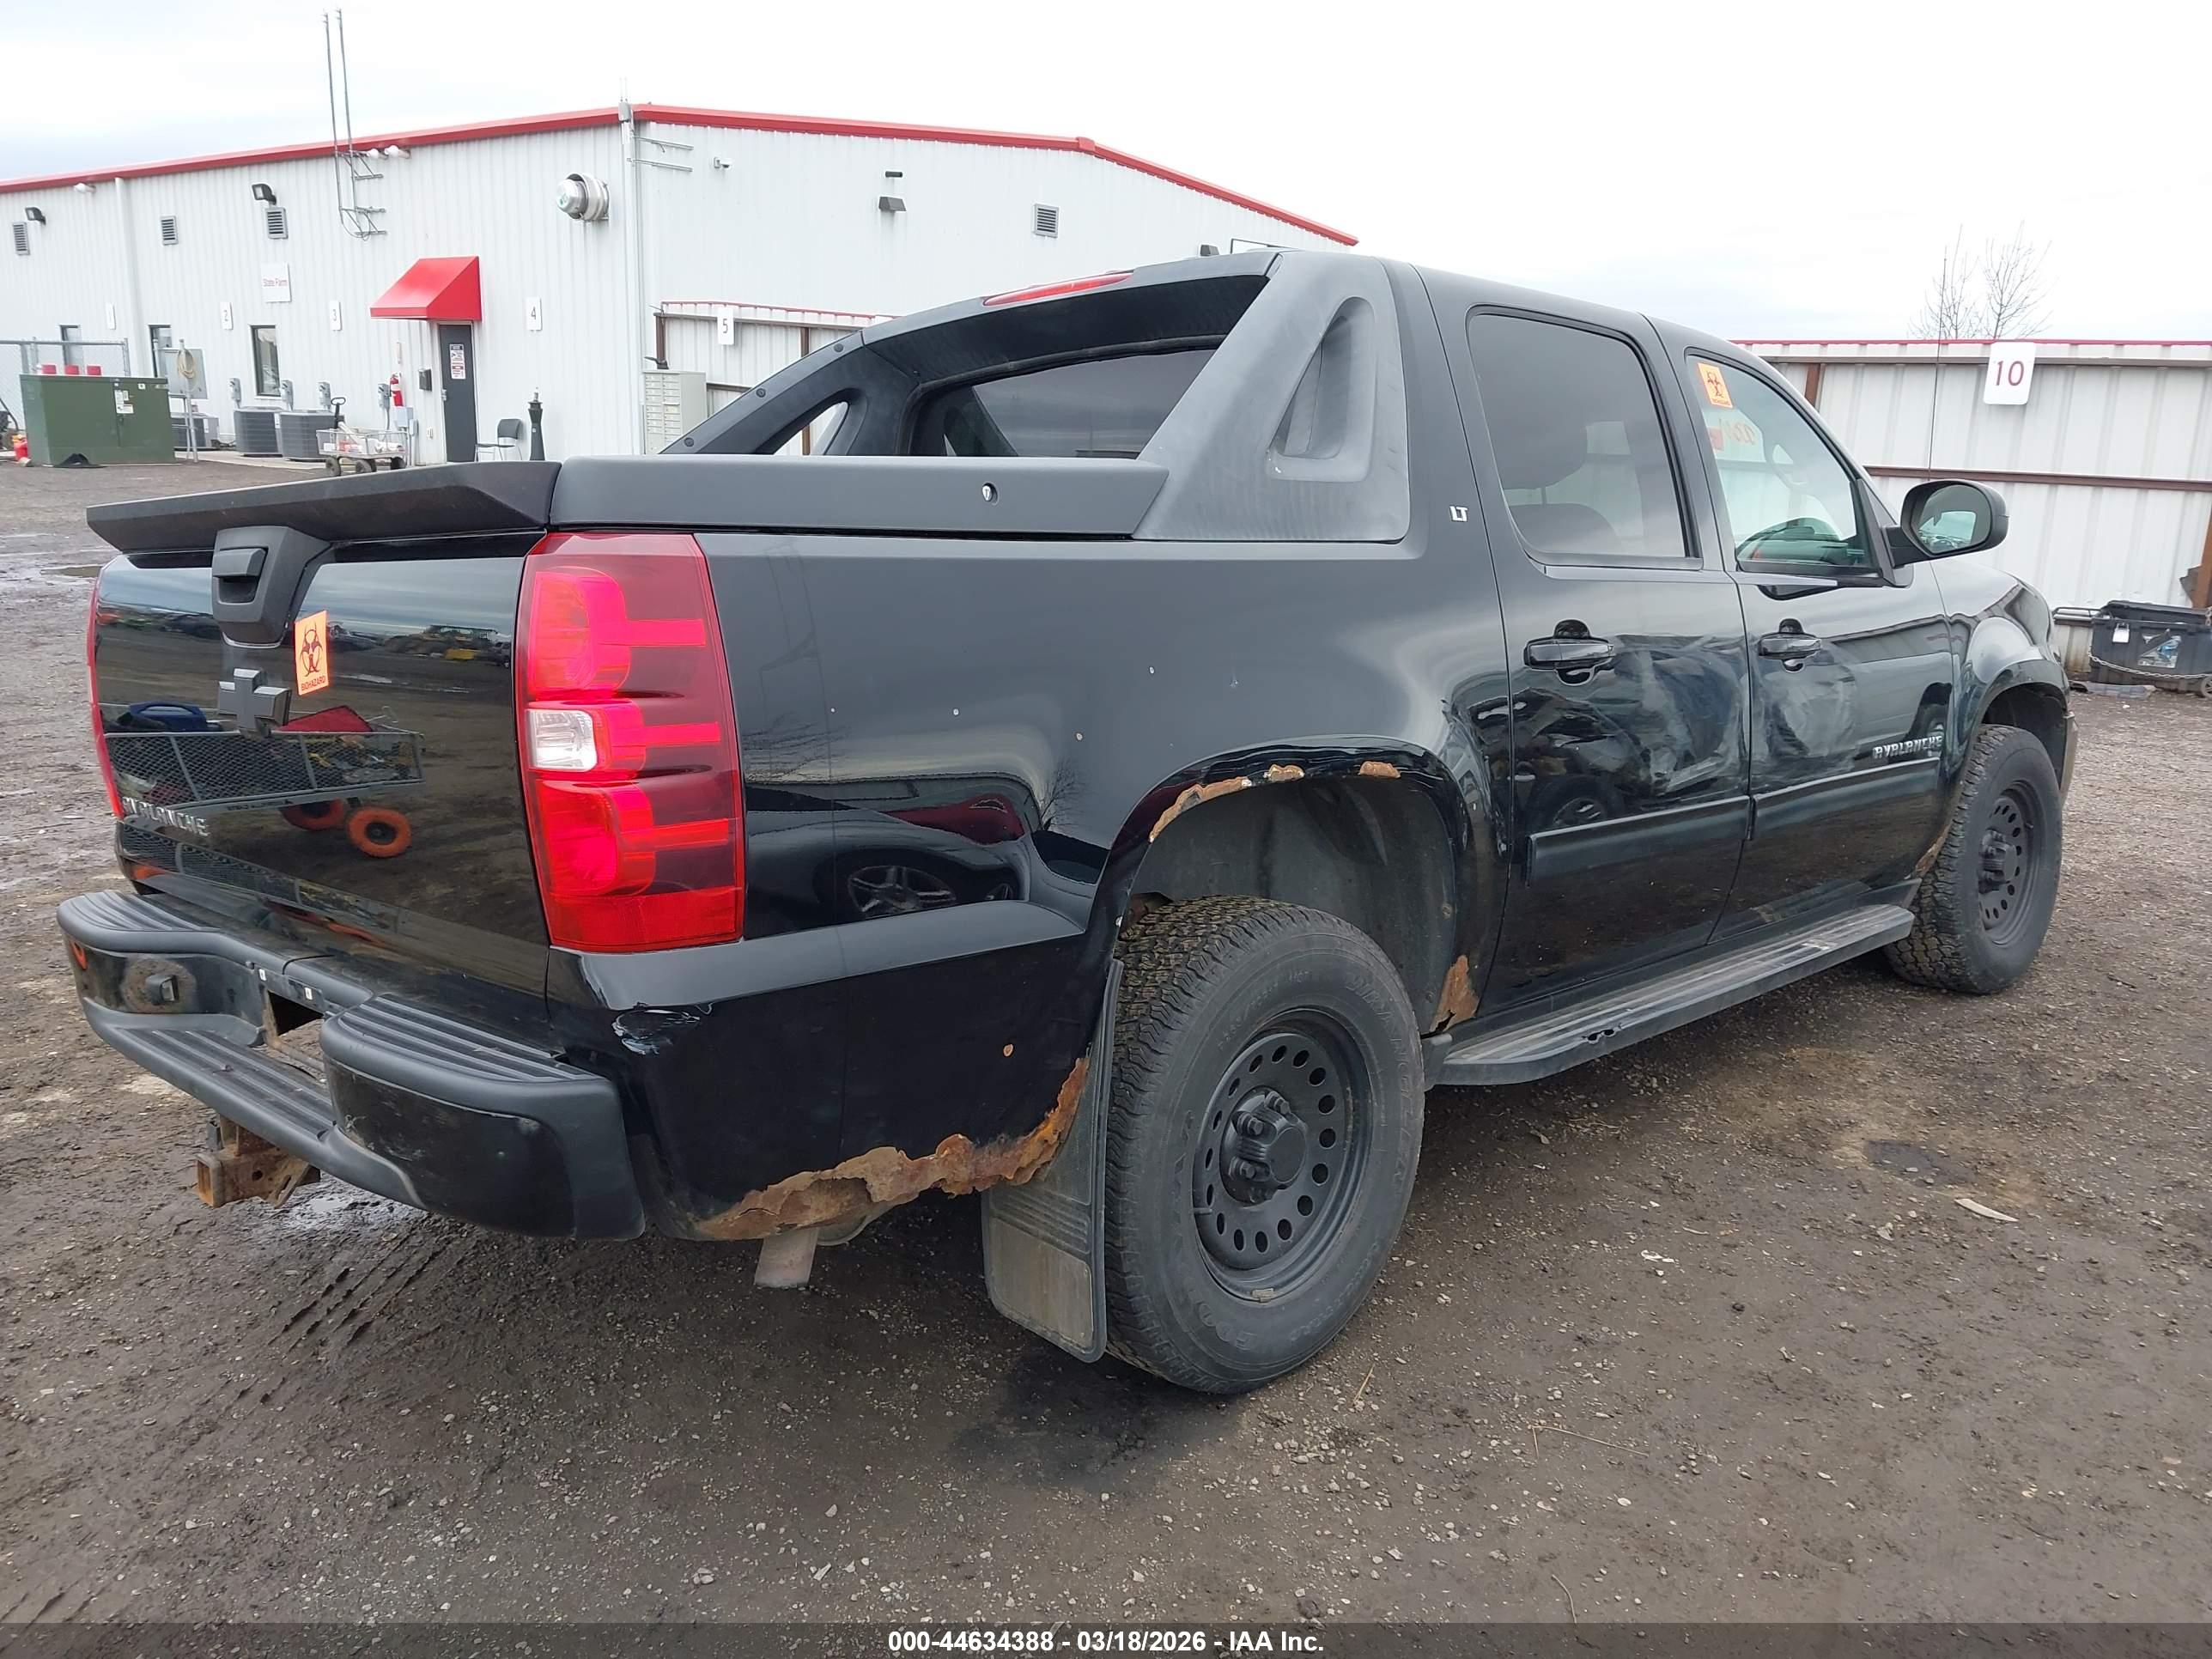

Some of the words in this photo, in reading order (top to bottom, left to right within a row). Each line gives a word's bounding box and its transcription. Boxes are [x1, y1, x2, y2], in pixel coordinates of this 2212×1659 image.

[722, 318, 728, 334] 5
[1996, 360, 2025, 386] 10
[1449, 506, 1468, 522] LT
[301, 675, 326, 691] BIOHAZARD
[1872, 735, 1943, 759] AVALANCHE
[122, 796, 210, 837] AVALANCHE
